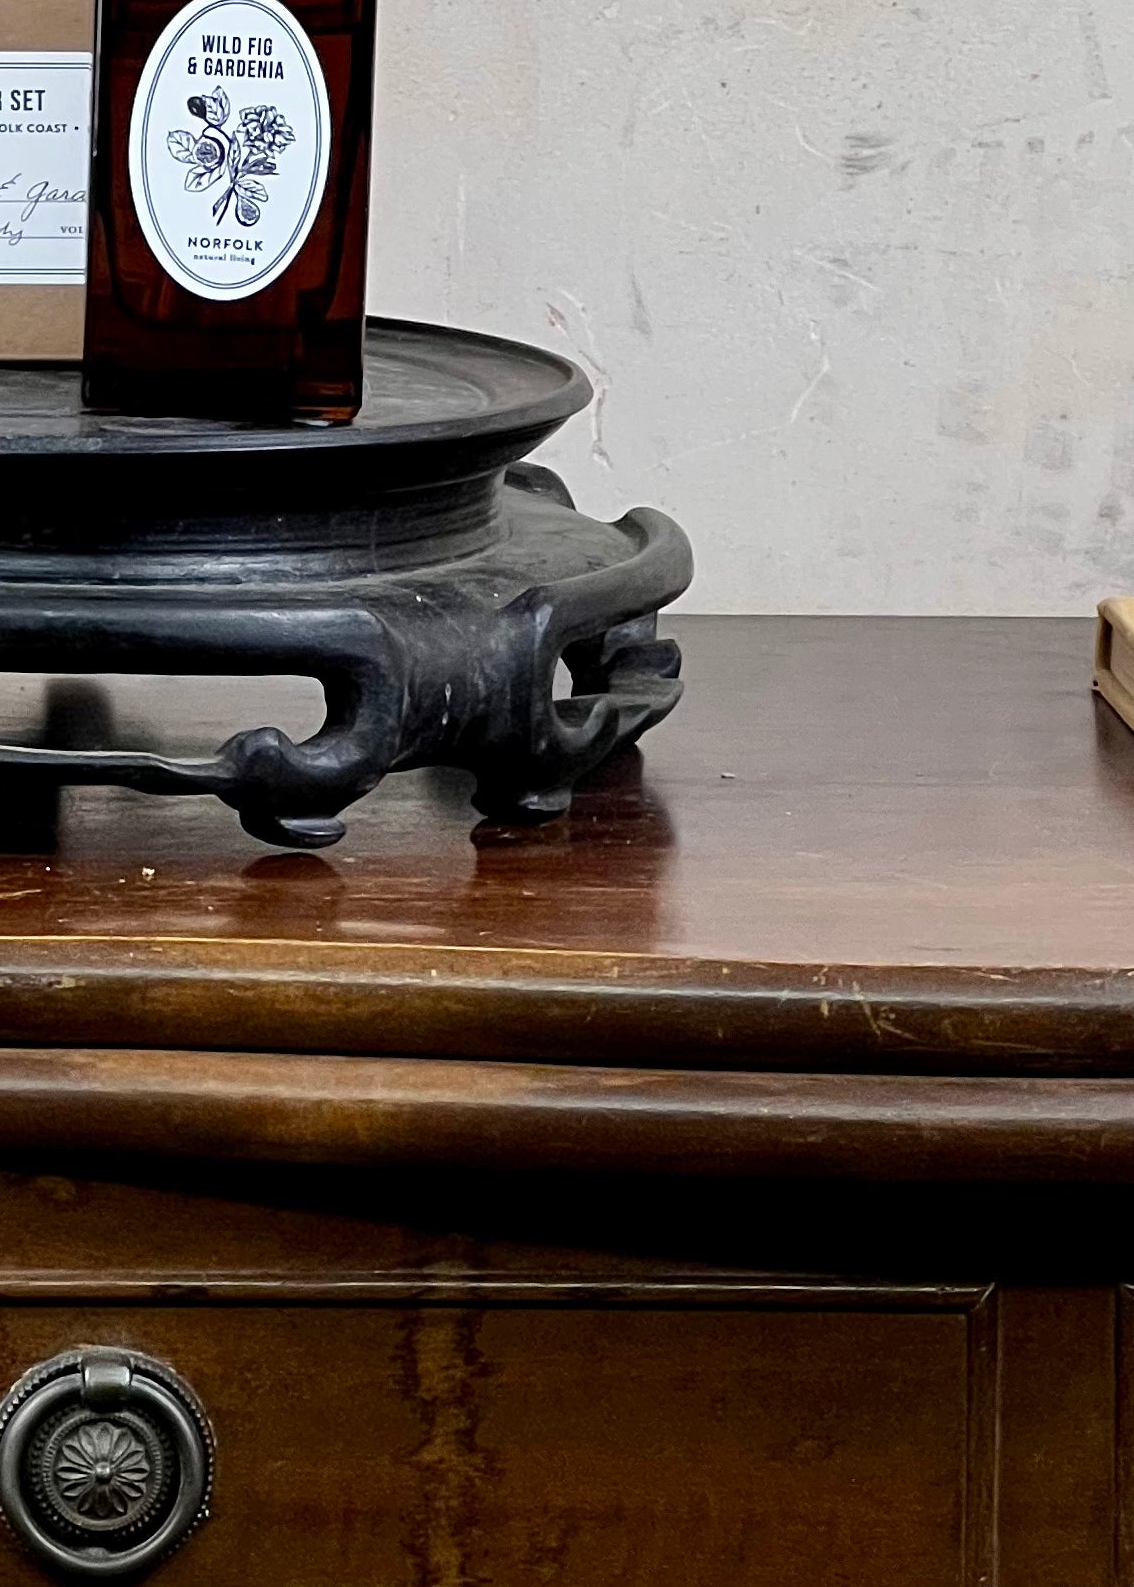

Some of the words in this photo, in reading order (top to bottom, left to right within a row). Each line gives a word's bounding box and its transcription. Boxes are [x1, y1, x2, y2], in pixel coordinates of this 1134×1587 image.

[202, 34, 241, 54] WILD
[248, 37, 272, 56] FIG
[187, 57, 197, 74] &
[204, 57, 284, 80] GARDENIA
[10, 89, 46, 111] SET
[26, 123, 67, 133] COAST
[187, 237, 263, 251] NORFOLK
